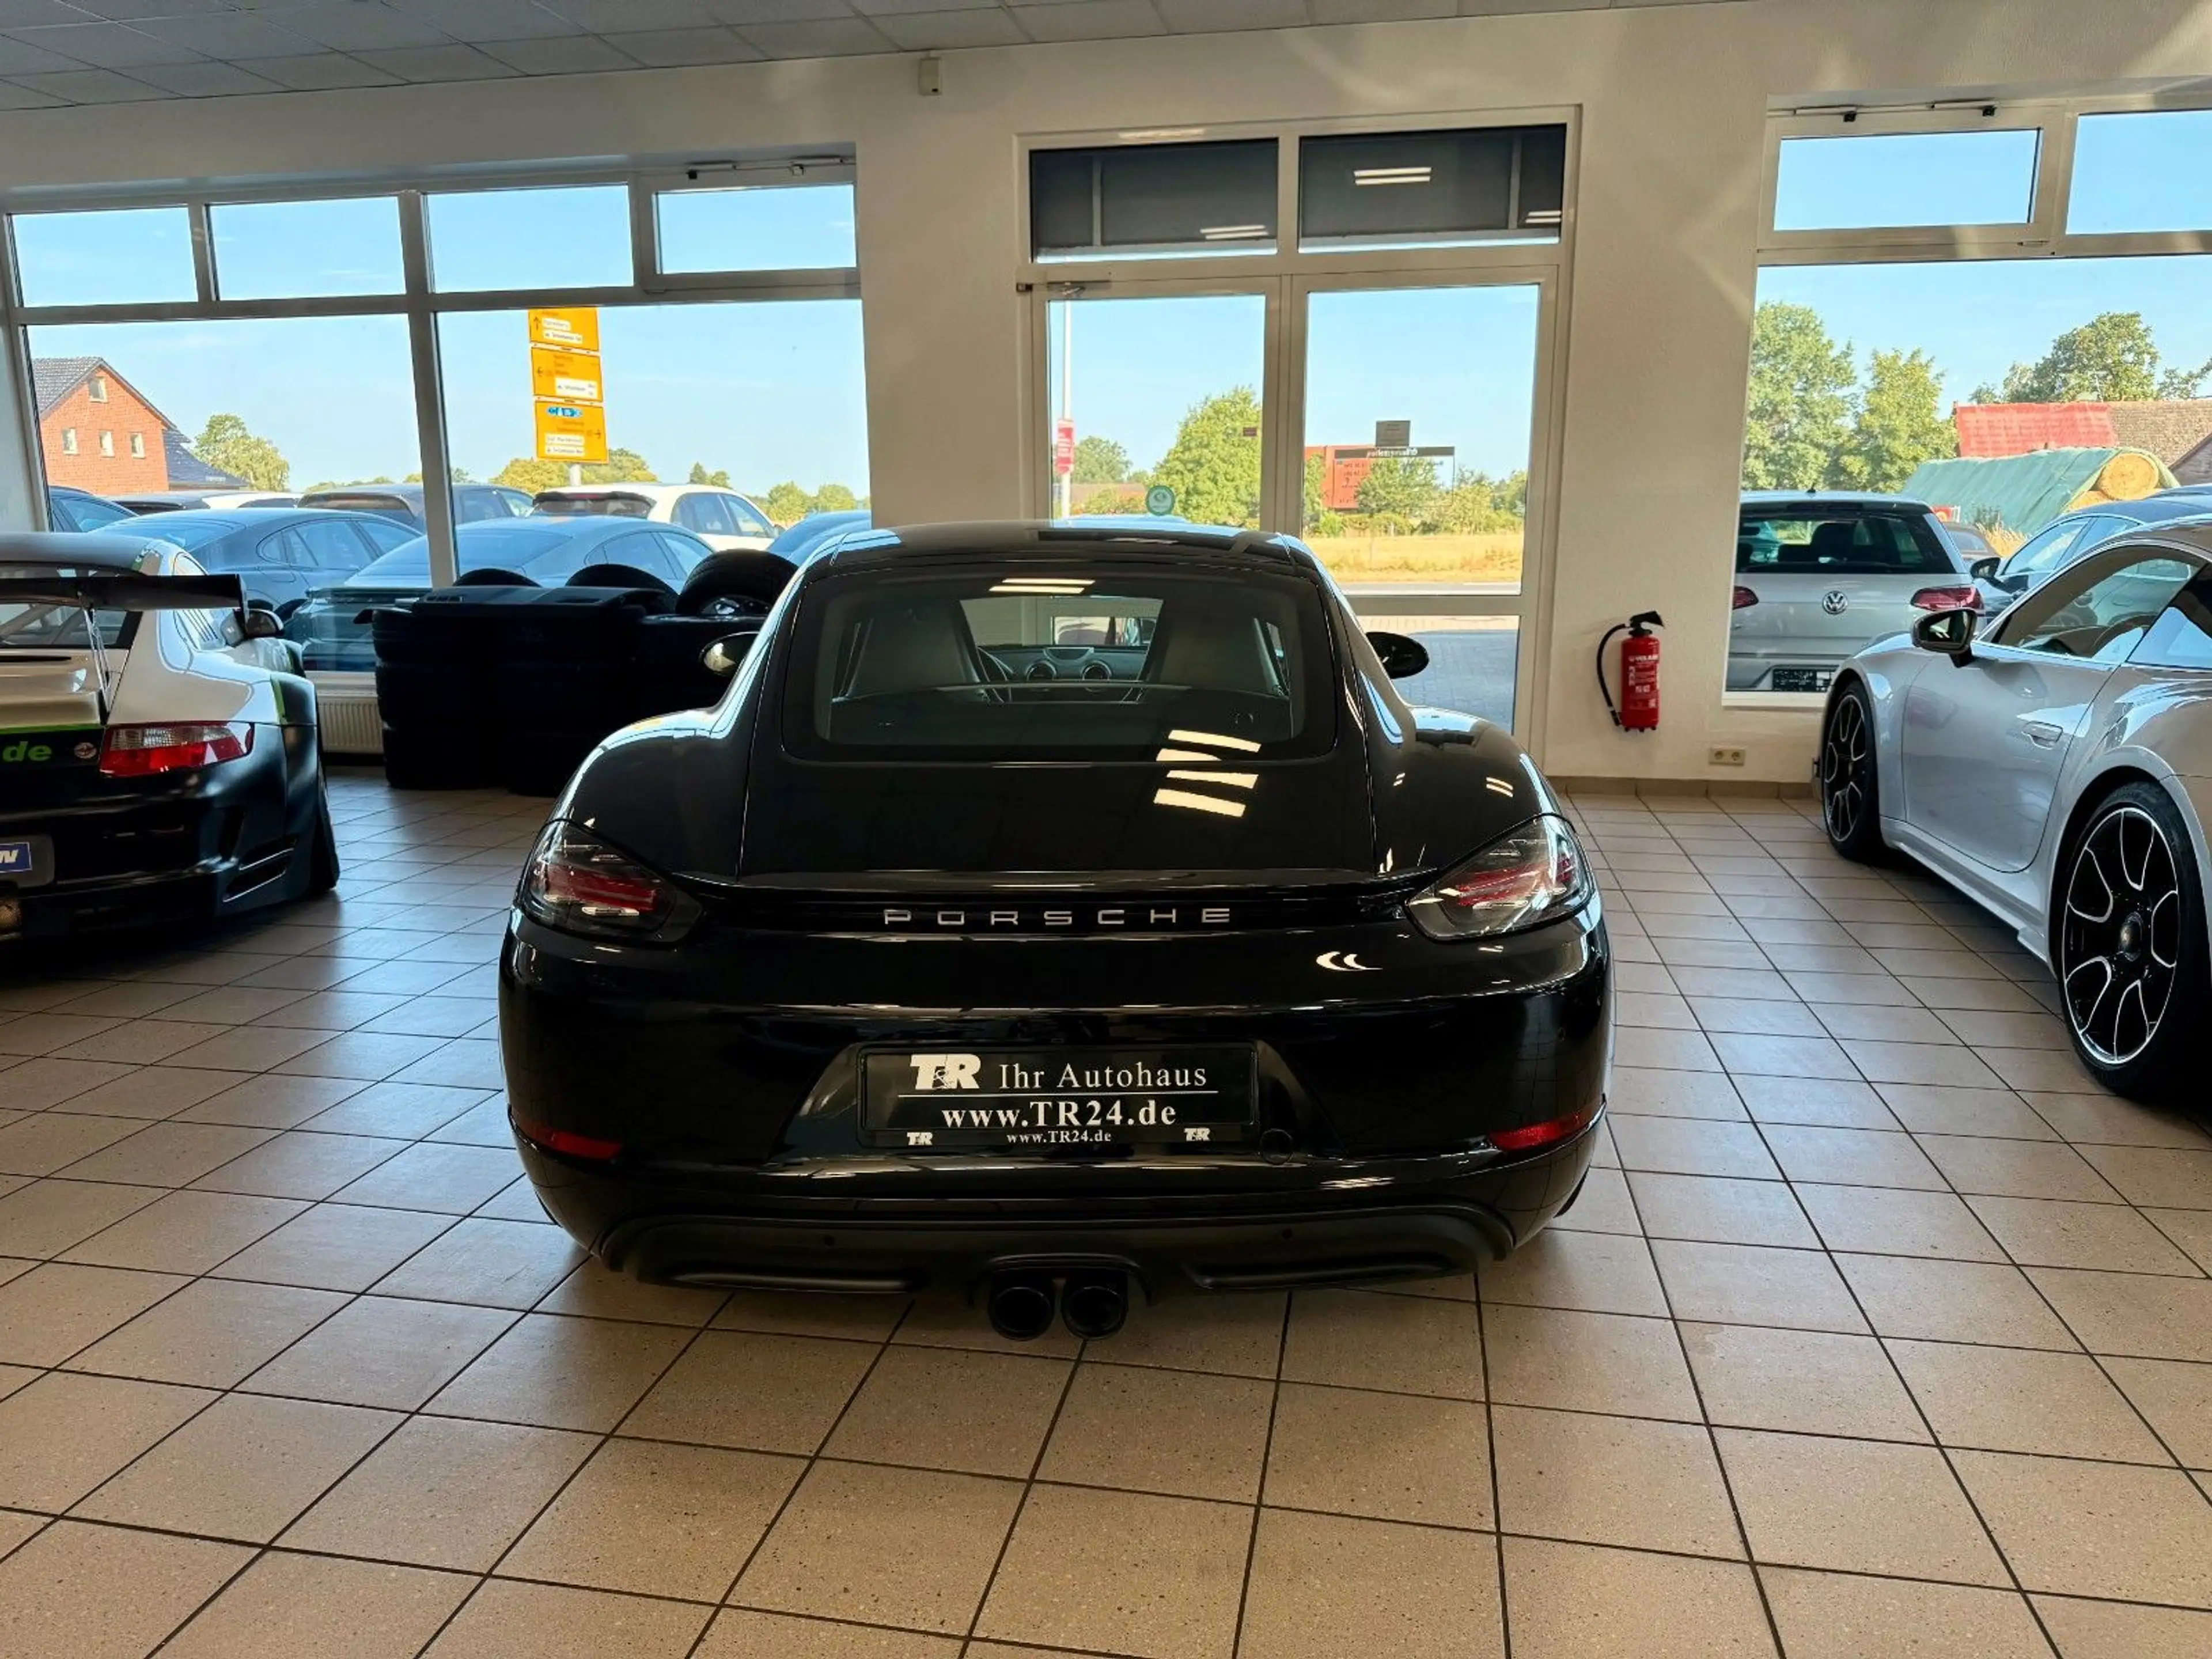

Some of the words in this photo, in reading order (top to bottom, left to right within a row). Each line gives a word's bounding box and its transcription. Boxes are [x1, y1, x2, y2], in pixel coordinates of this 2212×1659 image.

[884, 908, 1230, 925] PORSCHE
[998, 1063, 1046, 1089] Ihr
[1056, 1061, 1207, 1088] Autohaus
[941, 1100, 1176, 1128] www.TR24.de
[1006, 1129, 1112, 1143] www.TR24.de
